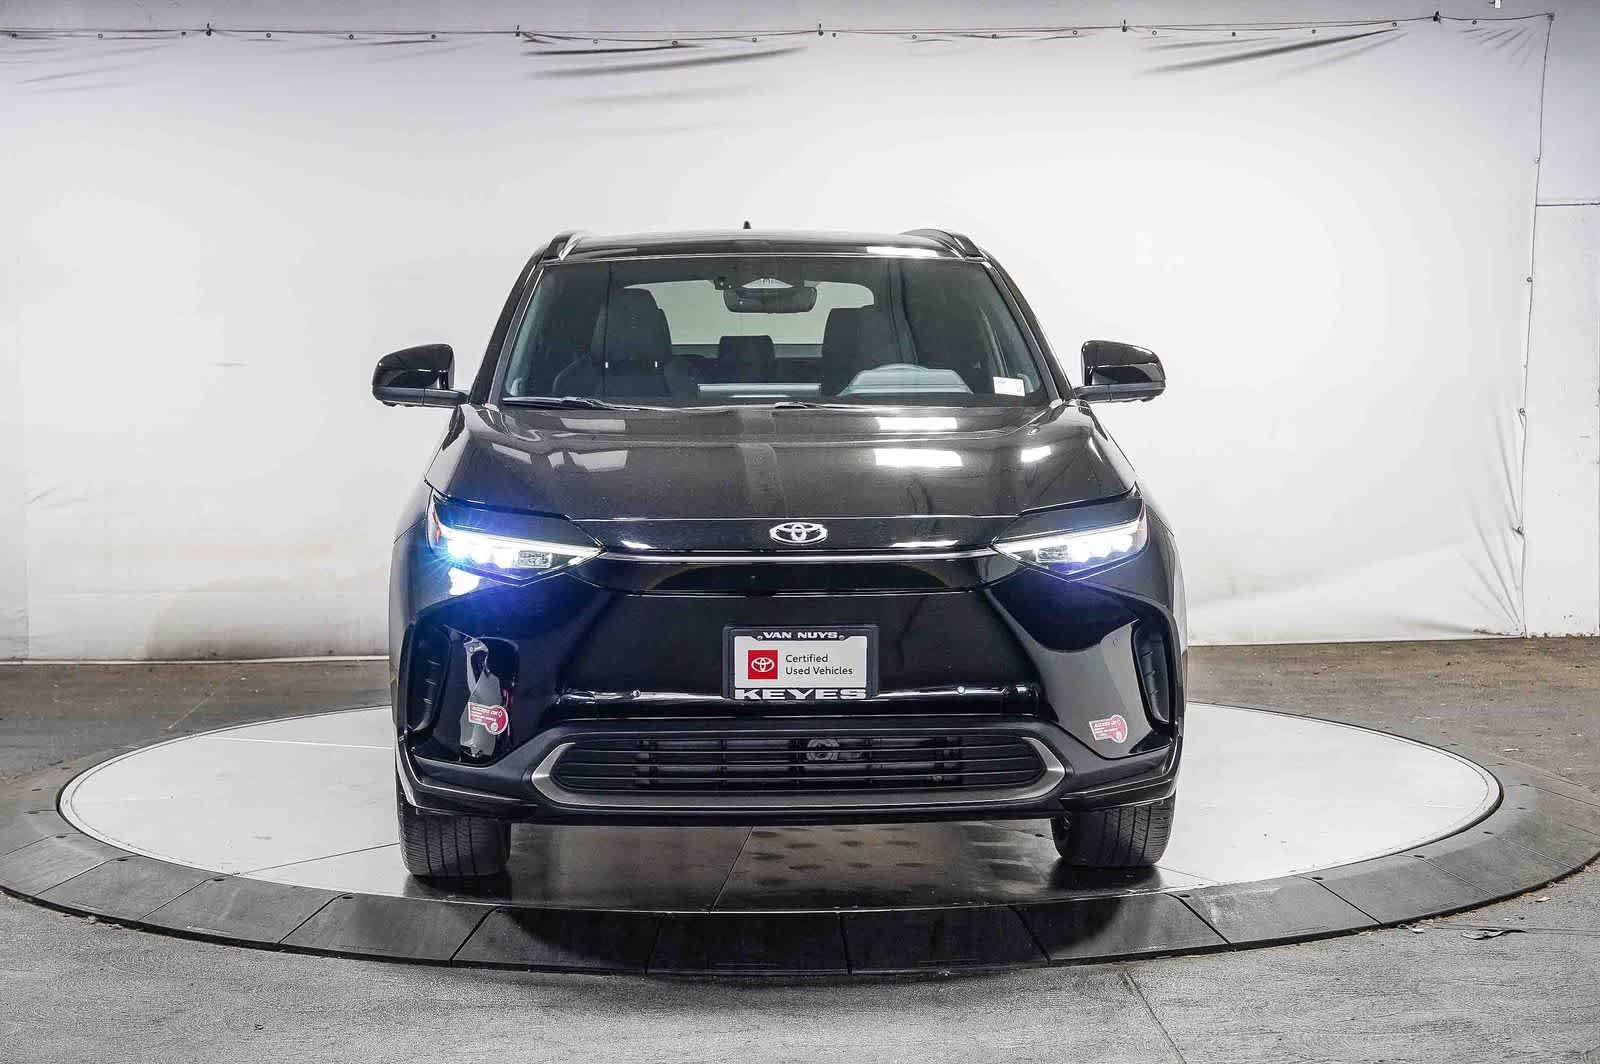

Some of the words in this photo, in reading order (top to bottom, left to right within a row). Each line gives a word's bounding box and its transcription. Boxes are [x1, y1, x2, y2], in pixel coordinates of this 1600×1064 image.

[785, 654, 828, 663] Certified
[785, 666, 811, 675] Used
[813, 666, 853, 675] Vehicles
[735, 689, 866, 700] KEYES
